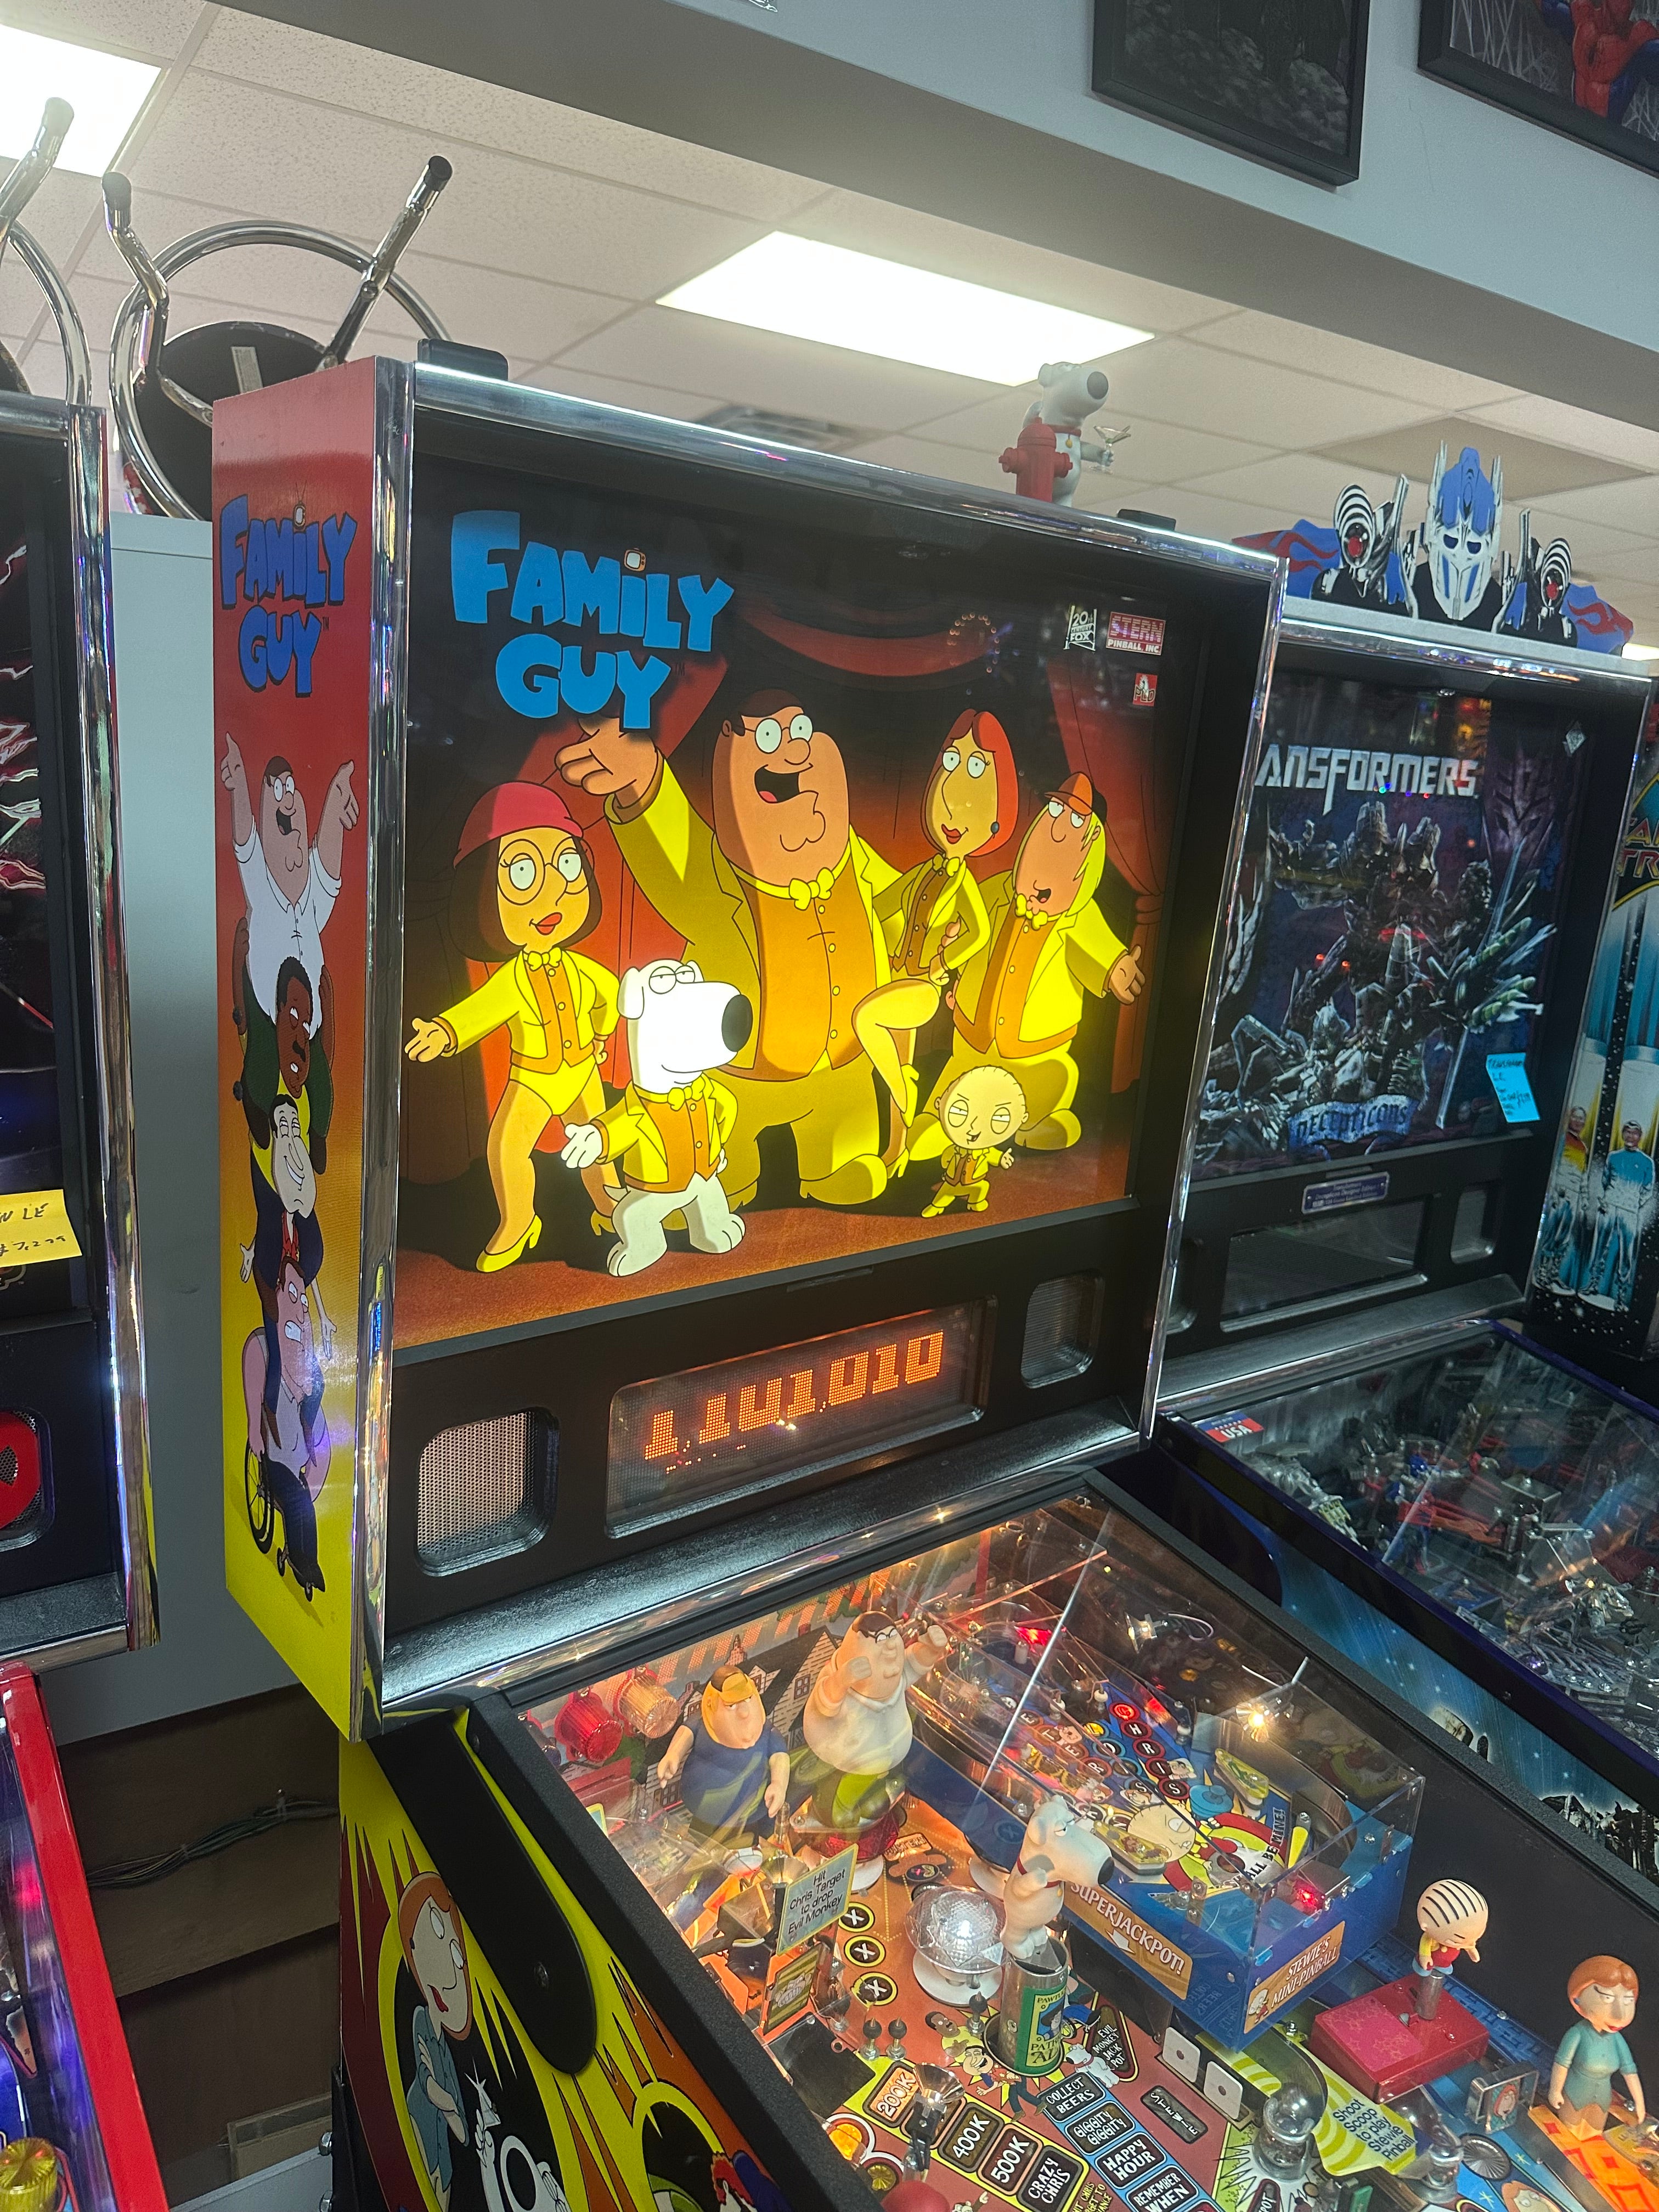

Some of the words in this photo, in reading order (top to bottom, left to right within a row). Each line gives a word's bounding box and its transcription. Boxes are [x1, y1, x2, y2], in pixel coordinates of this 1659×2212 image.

[1070, 631, 1090, 642] FOX
[1110, 615, 1163, 643] STERN
[238, 605, 322, 698] GUY
[495, 634, 672, 730] GUY
[1255, 743, 1479, 816] ANSFORMERS
[1220, 1425, 1253, 1439] USA
[1270, 1807, 1286, 1847] MINE!
[1262, 1845, 1280, 1862] BE
[789, 1888, 813, 1910] Chris
[816, 1868, 846, 1892] Target
[813, 1870, 826, 1886] Hit
[788, 1917, 805, 1935] Evil
[805, 1893, 843, 1925] Monkey
[801, 1903, 810, 1915] to
[812, 1889, 834, 1909] drop
[854, 1943, 876, 1960] X
[1287, 1935, 1333, 1980] STEWIE'S
[1271, 1946, 1339, 2008] MINI-PINBALL
[1092, 2032, 1120, 2055] MONKEY
[1097, 2023, 1118, 2038] EVIL
[1031, 2047, 1058, 2064] AL
[1101, 2044, 1123, 2062] JACK
[1110, 2055, 1126, 2070] POT
[877, 2071, 917, 2118] 200K
[1046, 2076, 1085, 2105] COLLECT
[1056, 2089, 1096, 2115] BEERS
[1150, 2092, 1199, 2136] STEWIE
[1333, 2097, 1365, 2121] Shoot
[1344, 2107, 1378, 2133] Scoop
[952, 2113, 991, 2160] 400K
[1073, 2111, 1114, 2138] GIGGITY
[1087, 2117, 1128, 2146] GIGGITY
[1356, 2129, 1368, 2142] to
[1371, 2115, 1392, 2140] play
[1368, 2125, 1404, 2153] Stewie
[1382, 2135, 1417, 2162] Pinball
[990, 2134, 1031, 2184] 500K
[1102, 2138, 1148, 2169] HAPPY
[1113, 2151, 1156, 2181] HOUR
[1028, 2157, 1059, 2200] CRAZY
[1041, 2168, 1071, 2204] CHRIS
[1080, 2181, 1096, 2202] CHRIS
[1094, 2183, 1106, 2196] TO
[1132, 2171, 1182, 2207] REMEMBER
[1145, 2183, 1190, 2212] WHEN
